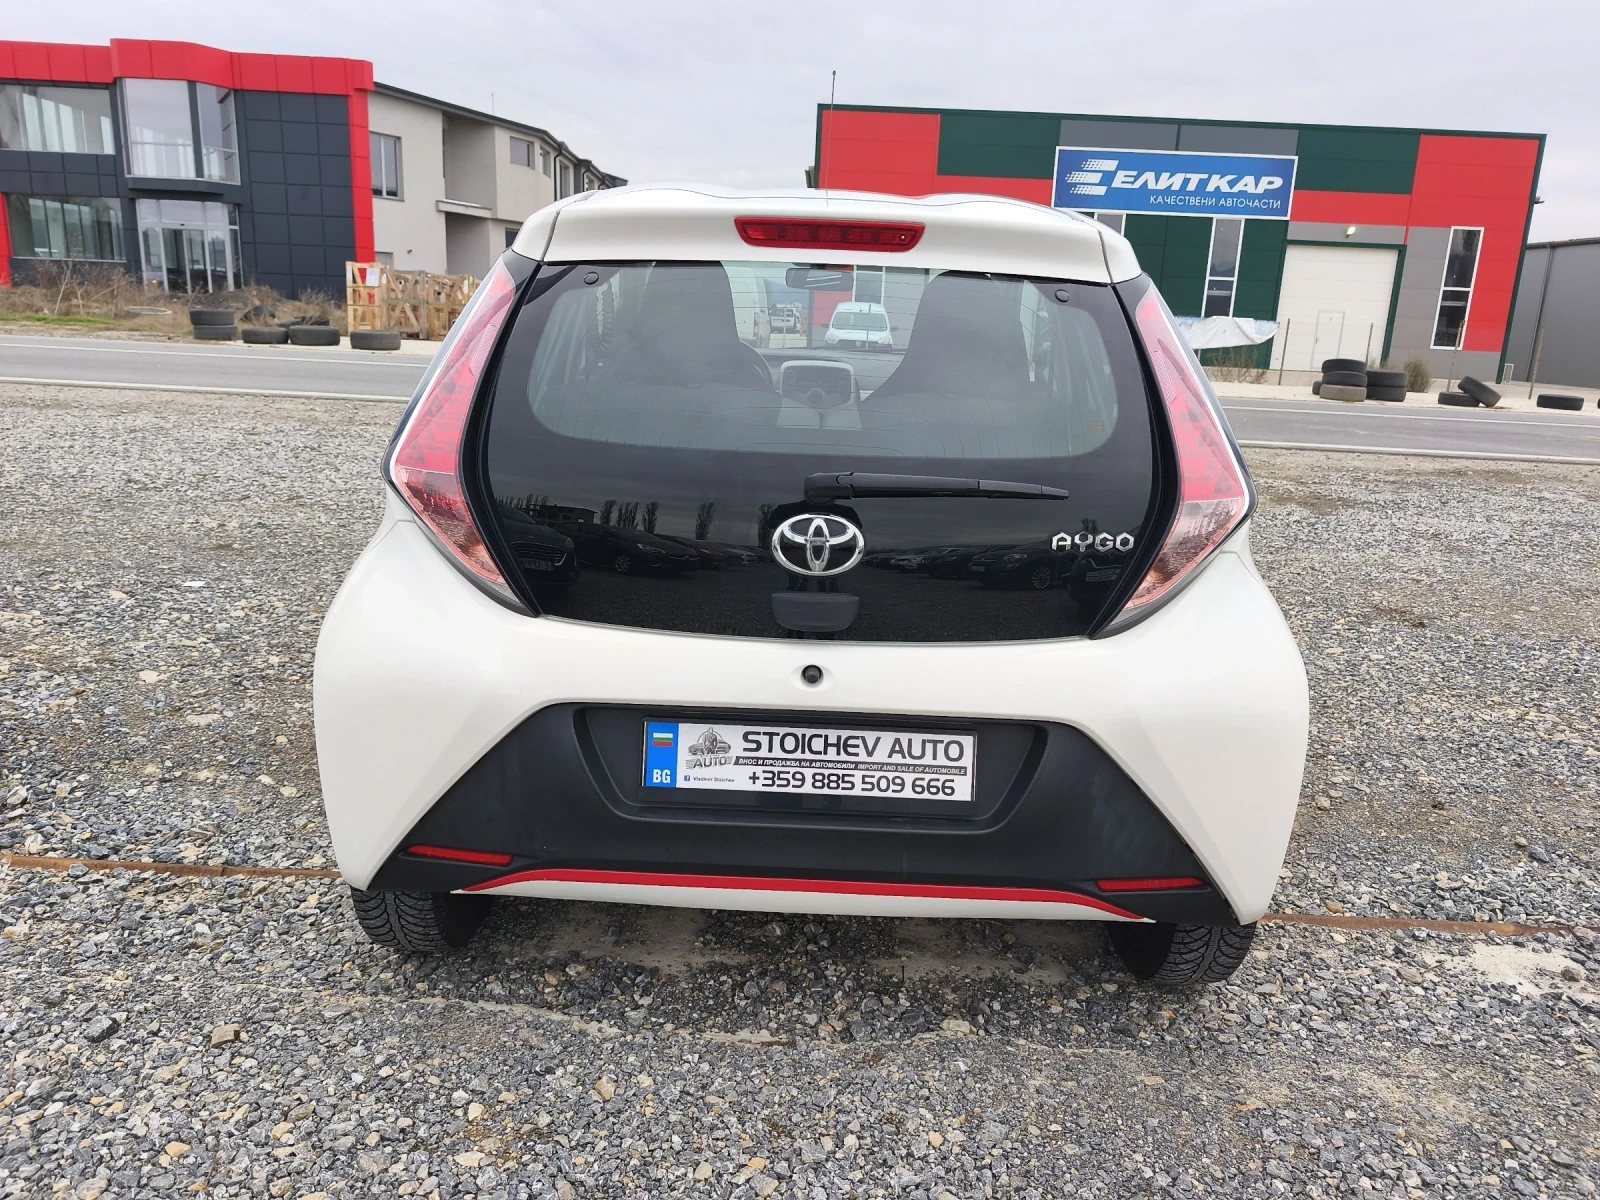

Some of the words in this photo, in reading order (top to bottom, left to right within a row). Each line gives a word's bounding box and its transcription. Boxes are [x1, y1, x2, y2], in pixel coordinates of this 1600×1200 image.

[1149, 194, 1216, 207] КАЧЕСТВЕНИ
[1218, 196, 1281, 209] АВТОЧАСТИ
[1051, 531, 1135, 553] AYGO
[742, 730, 882, 759] STOICHEV
[887, 737, 965, 763] AUTO
[693, 755, 728, 769] AUTO
[763, 759, 800, 767] ПРОДАЖБА
[811, 761, 856, 769] АВТОМОБИЛИ
[857, 763, 882, 771] IMPORT
[924, 766, 966, 775] AUTOMOBILE
[652, 768, 671, 784] BG
[748, 769, 806, 789] +359
[811, 772, 856, 791] 885
[860, 774, 906, 793] 509
[911, 777, 956, 797] 666
